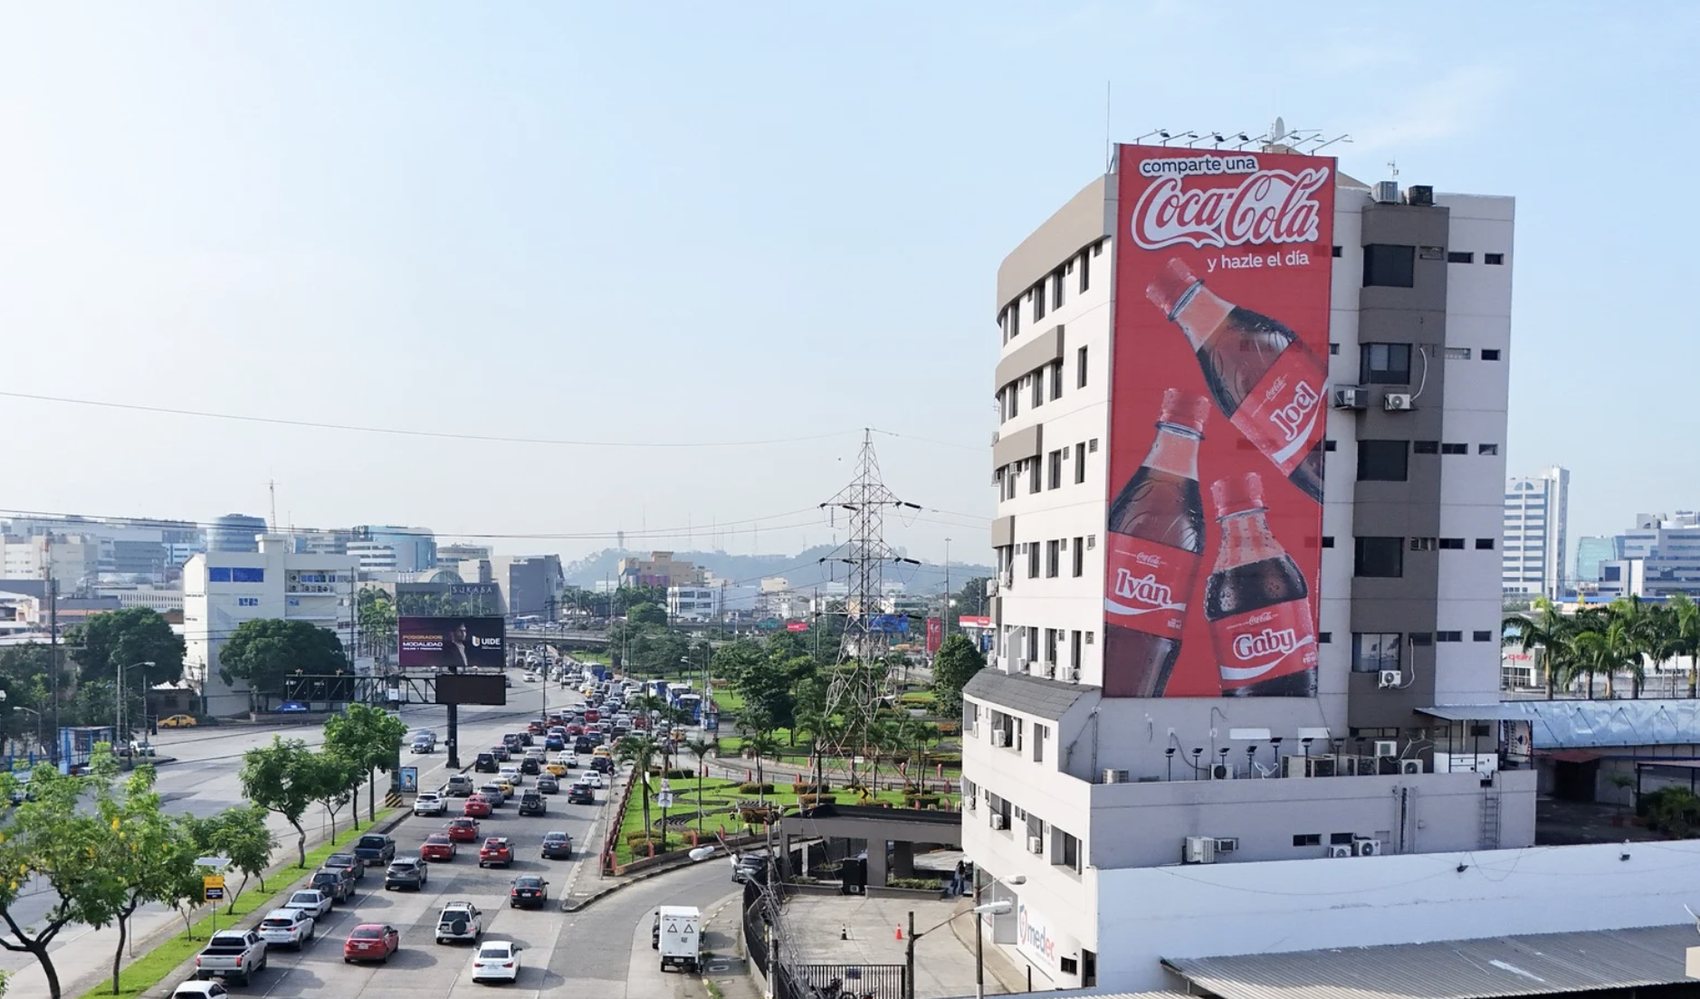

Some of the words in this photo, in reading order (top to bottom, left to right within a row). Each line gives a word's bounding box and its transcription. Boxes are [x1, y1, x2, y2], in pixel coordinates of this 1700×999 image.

[1142, 158, 1222, 176] comparte
[1226, 156, 1257, 171] una
[1132, 168, 1329, 249] Coca-Cola
[1207, 257, 1217, 273] y
[1221, 253, 1263, 269] hazle
[1267, 251, 1282, 266] el
[1286, 250, 1310, 266] día
[1270, 380, 1320, 441] Joel
[1115, 567, 1173, 604] Iván
[481, 637, 501, 645] UIDE
[1233, 628, 1297, 660] Gaby
